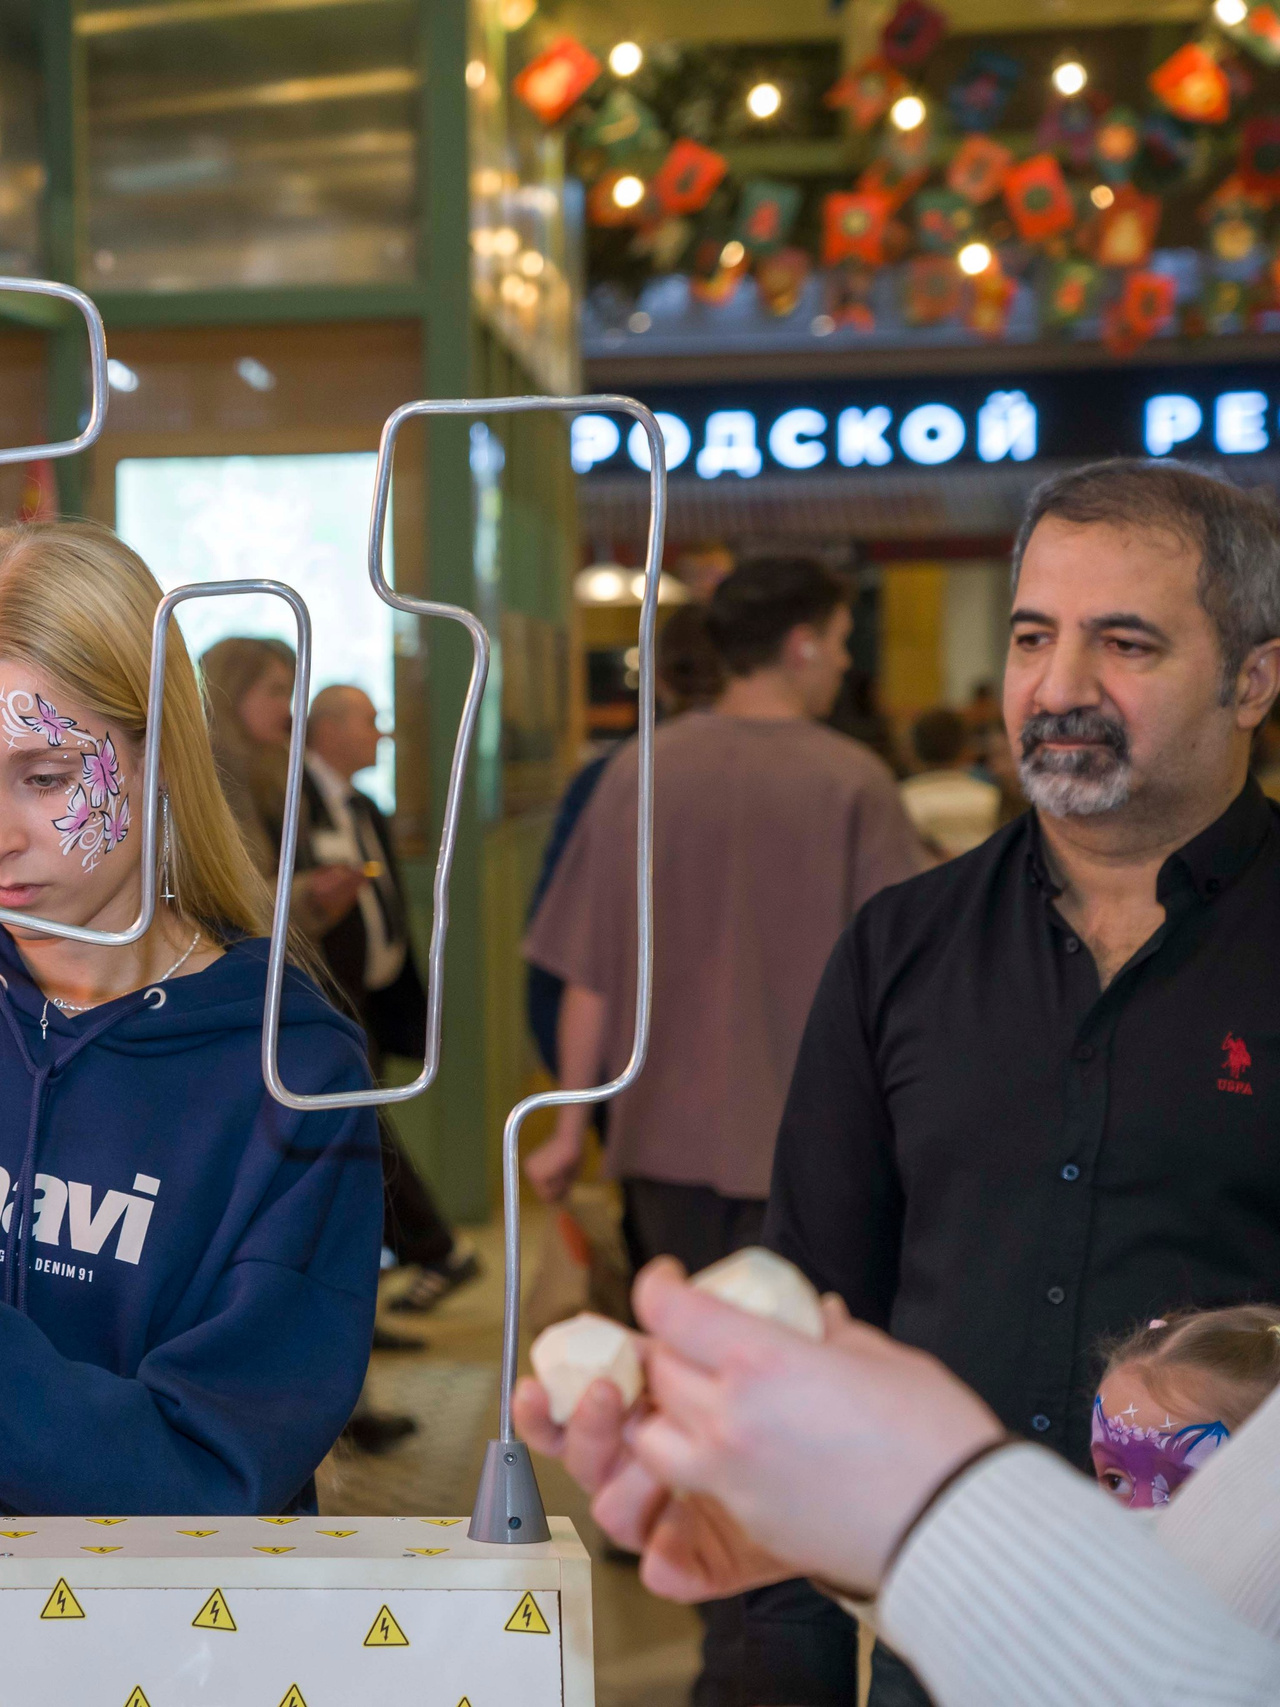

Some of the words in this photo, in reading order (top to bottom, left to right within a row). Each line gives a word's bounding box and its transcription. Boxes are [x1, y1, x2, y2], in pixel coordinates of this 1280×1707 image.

[570, 390, 1037, 480] РОДСКОЙ
[1145, 391, 1280, 457] РЕ
[34, 1257, 76, 1279] DENIM
[78, 1267, 94, 1283] 91
